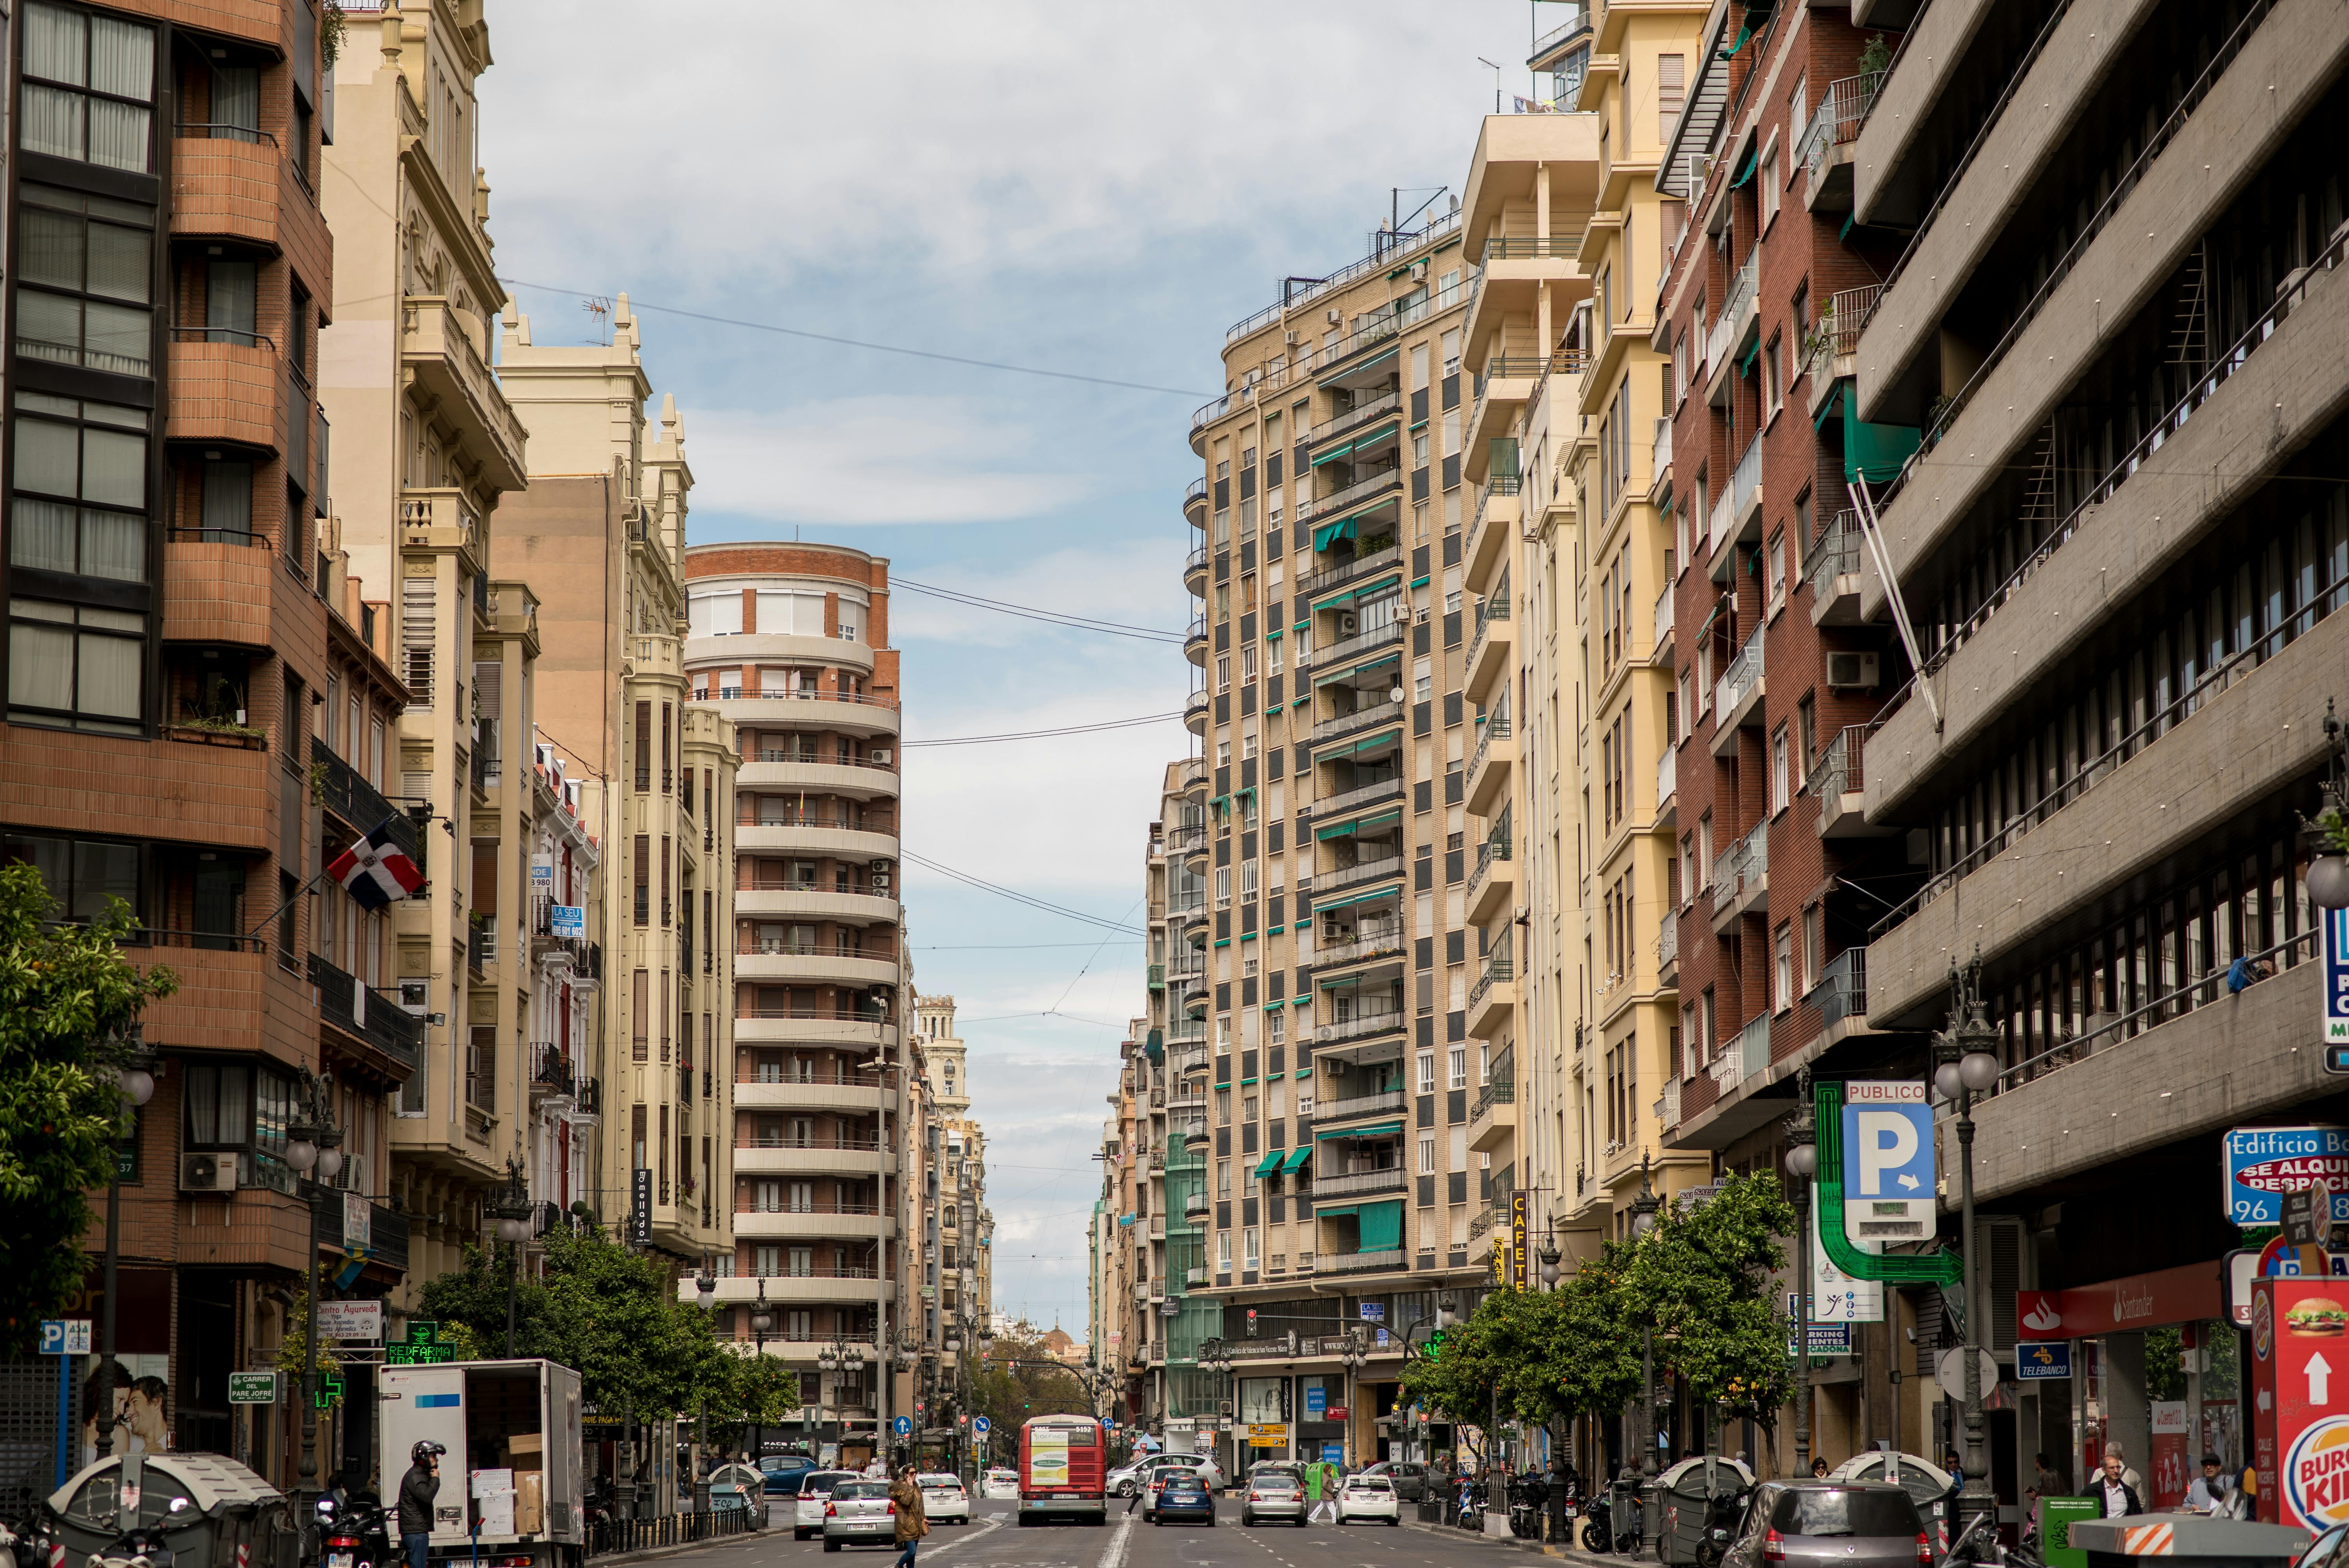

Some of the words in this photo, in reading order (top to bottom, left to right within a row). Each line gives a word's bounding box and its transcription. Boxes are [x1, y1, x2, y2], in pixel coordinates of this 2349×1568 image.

[554, 906, 562, 917] LA
[565, 907, 579, 917] SEU
[553, 925, 561, 935] 695
[562, 925, 571, 935] 601
[572, 926, 582, 936] 602
[2331, 1023, 2349, 1037] M
[1850, 1086, 1925, 1100] PUBLICO
[2233, 1133, 2317, 1154] Edificio
[1859, 1111, 1918, 1195] P
[2243, 1164, 2272, 1176] SE
[2291, 1196, 2306, 1210] CALLE
[2235, 1200, 2268, 1221] 96
[344, 1304, 377, 1315] Ayurveda
[2123, 1285, 2153, 1320] Santander
[44, 1324, 62, 1349] P
[2255, 1315, 2269, 1344] KING
[2023, 1365, 2067, 1376] TELEBANCO
[2160, 1410, 2174, 1425] Cuenta
[2258, 1438, 2272, 1452] CALLE
[2261, 1455, 2270, 1468] SAN
[2257, 1471, 2275, 1485] VICENTE
